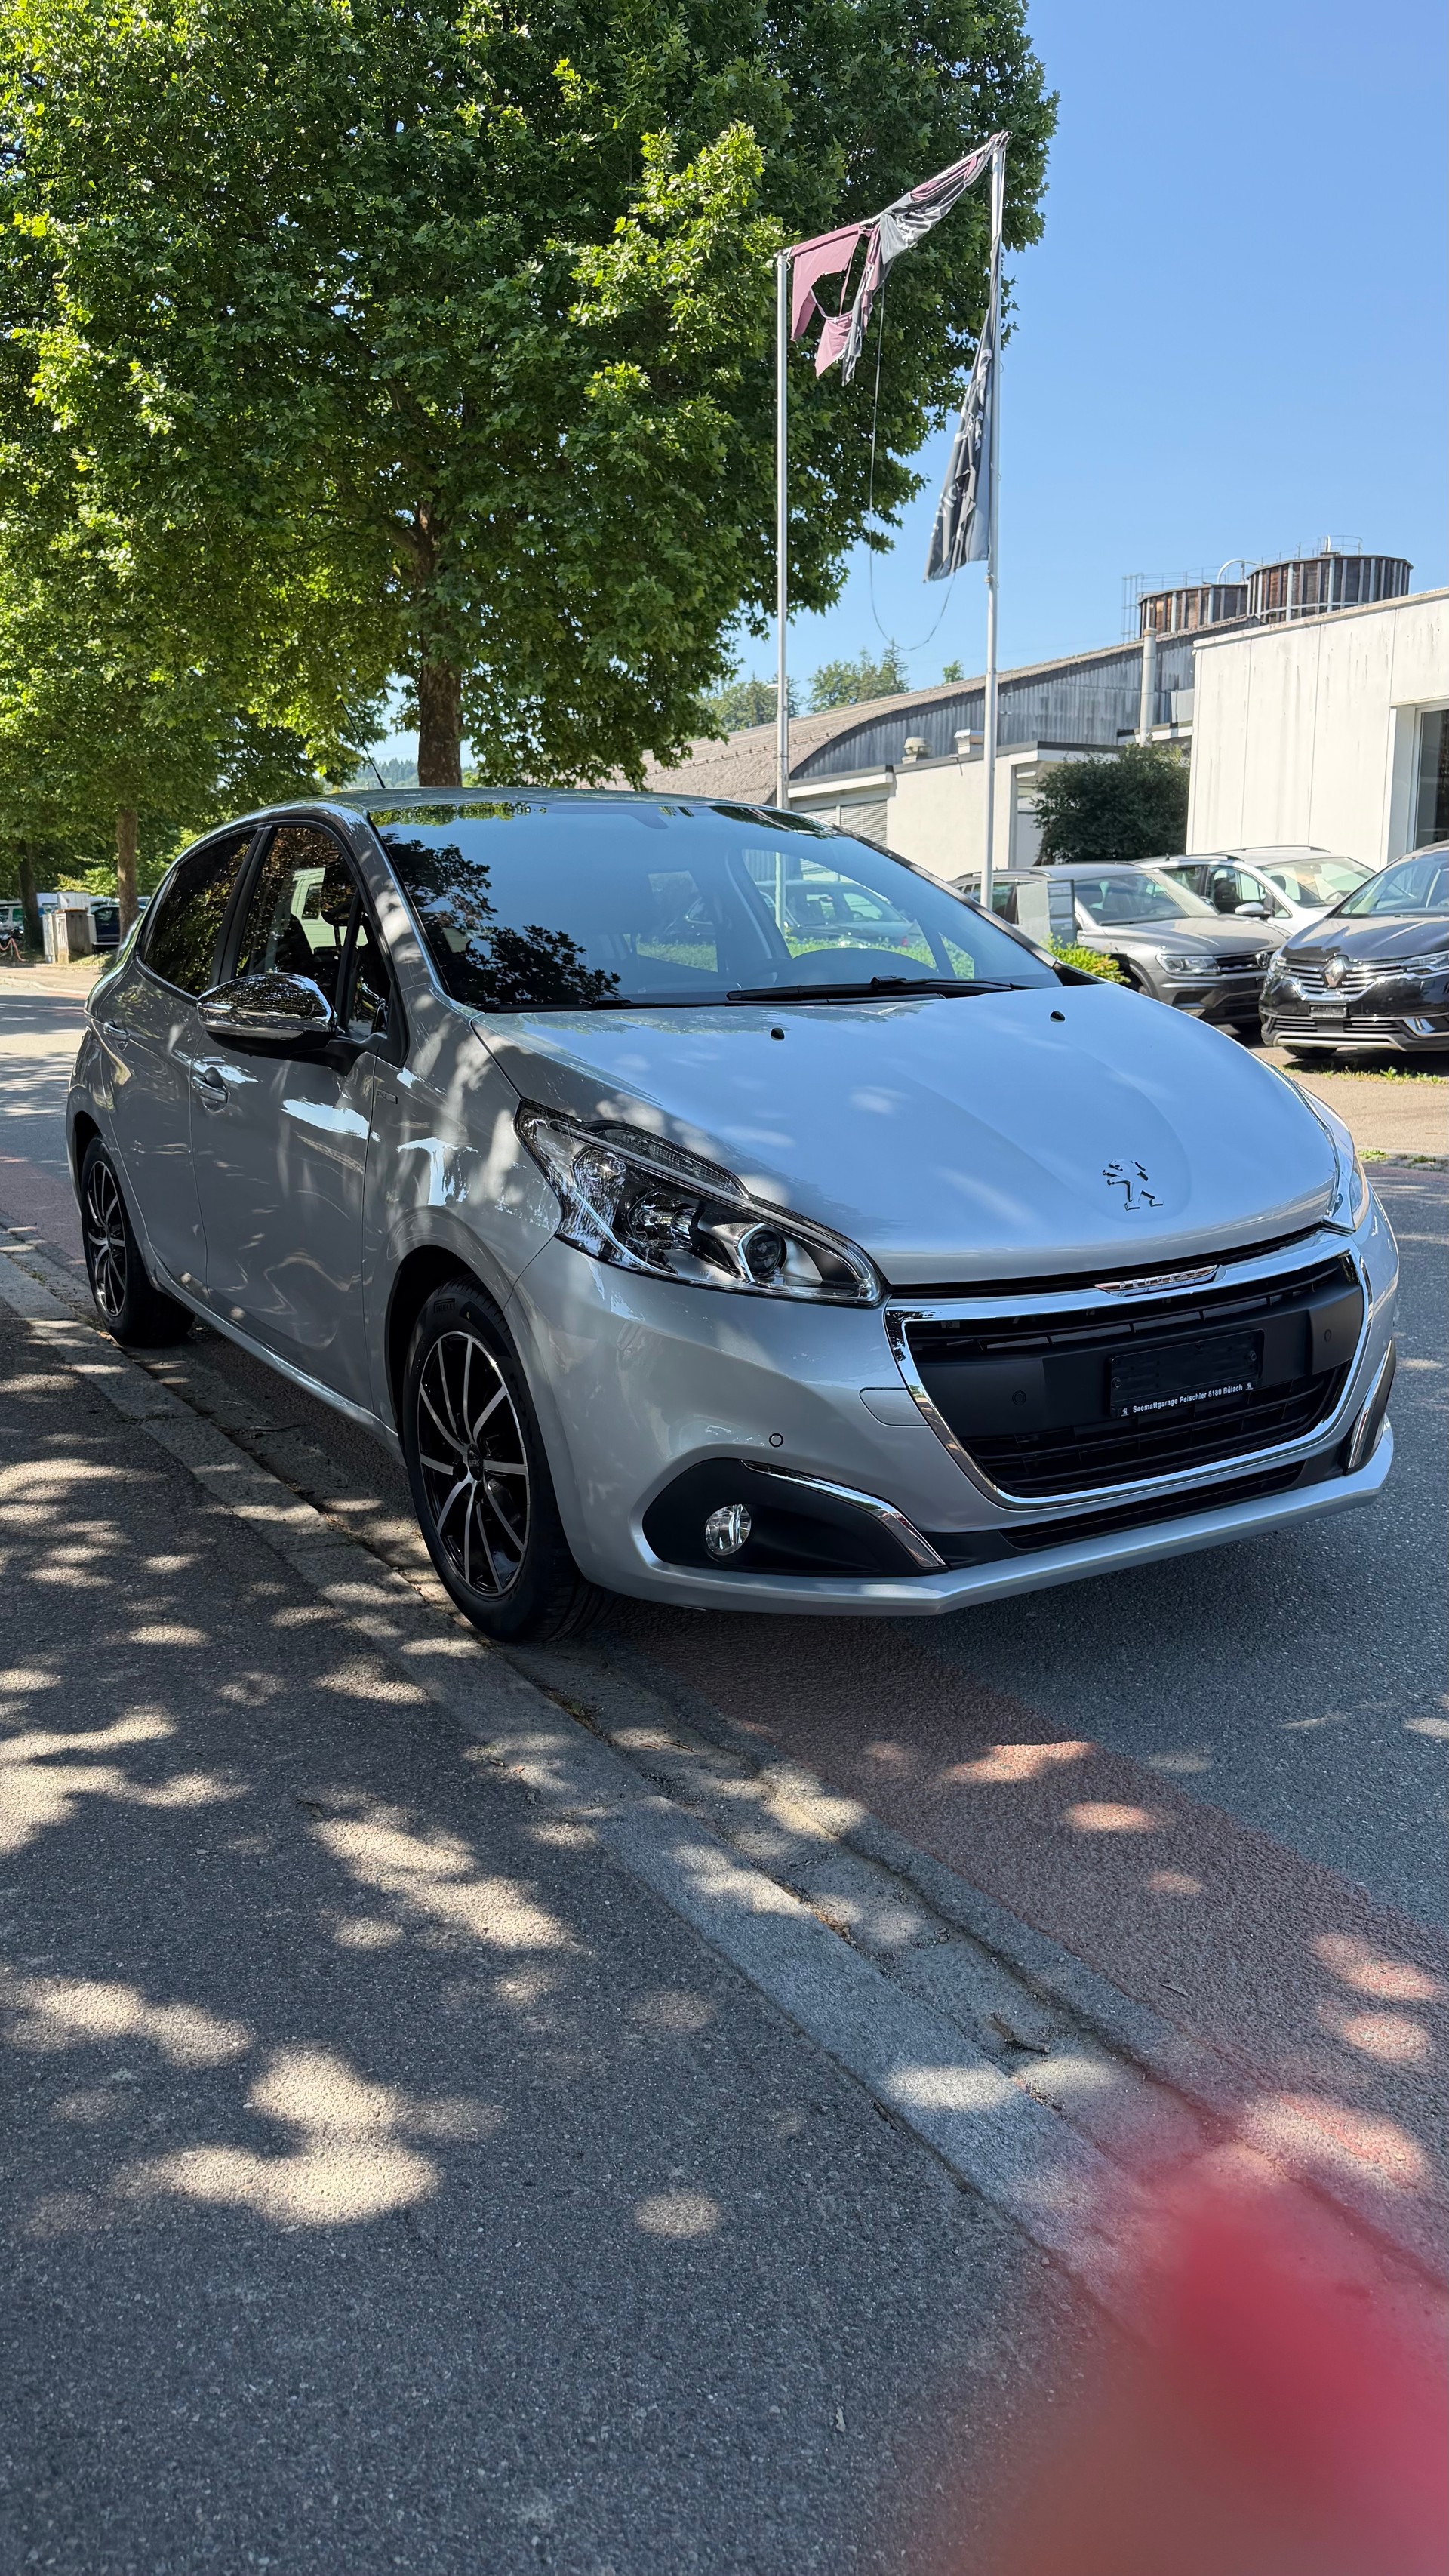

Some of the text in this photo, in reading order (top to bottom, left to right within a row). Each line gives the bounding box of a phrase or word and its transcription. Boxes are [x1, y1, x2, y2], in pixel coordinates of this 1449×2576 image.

[1133, 1399, 1178, 1413] Seemattgarage
[1208, 1386, 1222, 1398] 8180
[1223, 1383, 1243, 1395] Bülach
